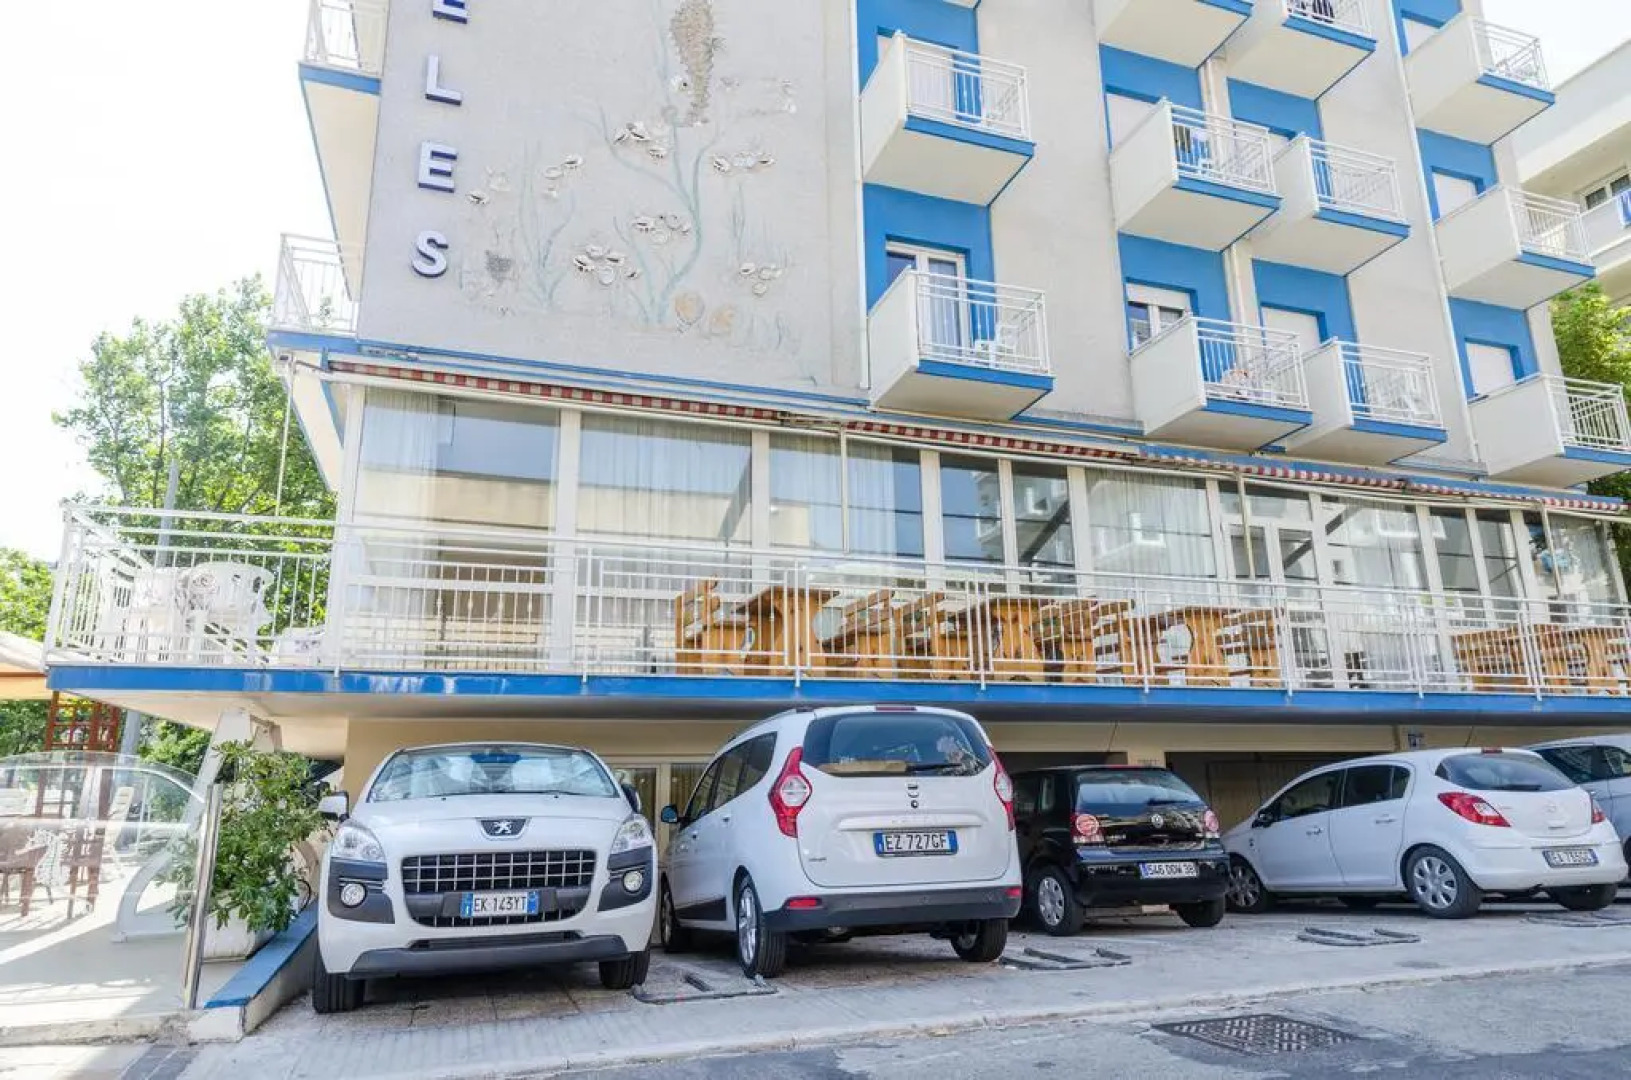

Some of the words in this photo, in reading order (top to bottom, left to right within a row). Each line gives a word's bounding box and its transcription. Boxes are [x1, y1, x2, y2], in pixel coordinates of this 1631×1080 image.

[885, 834, 903, 850] EZ
[906, 833, 947, 850] 727GF
[474, 898, 487, 912] EK
